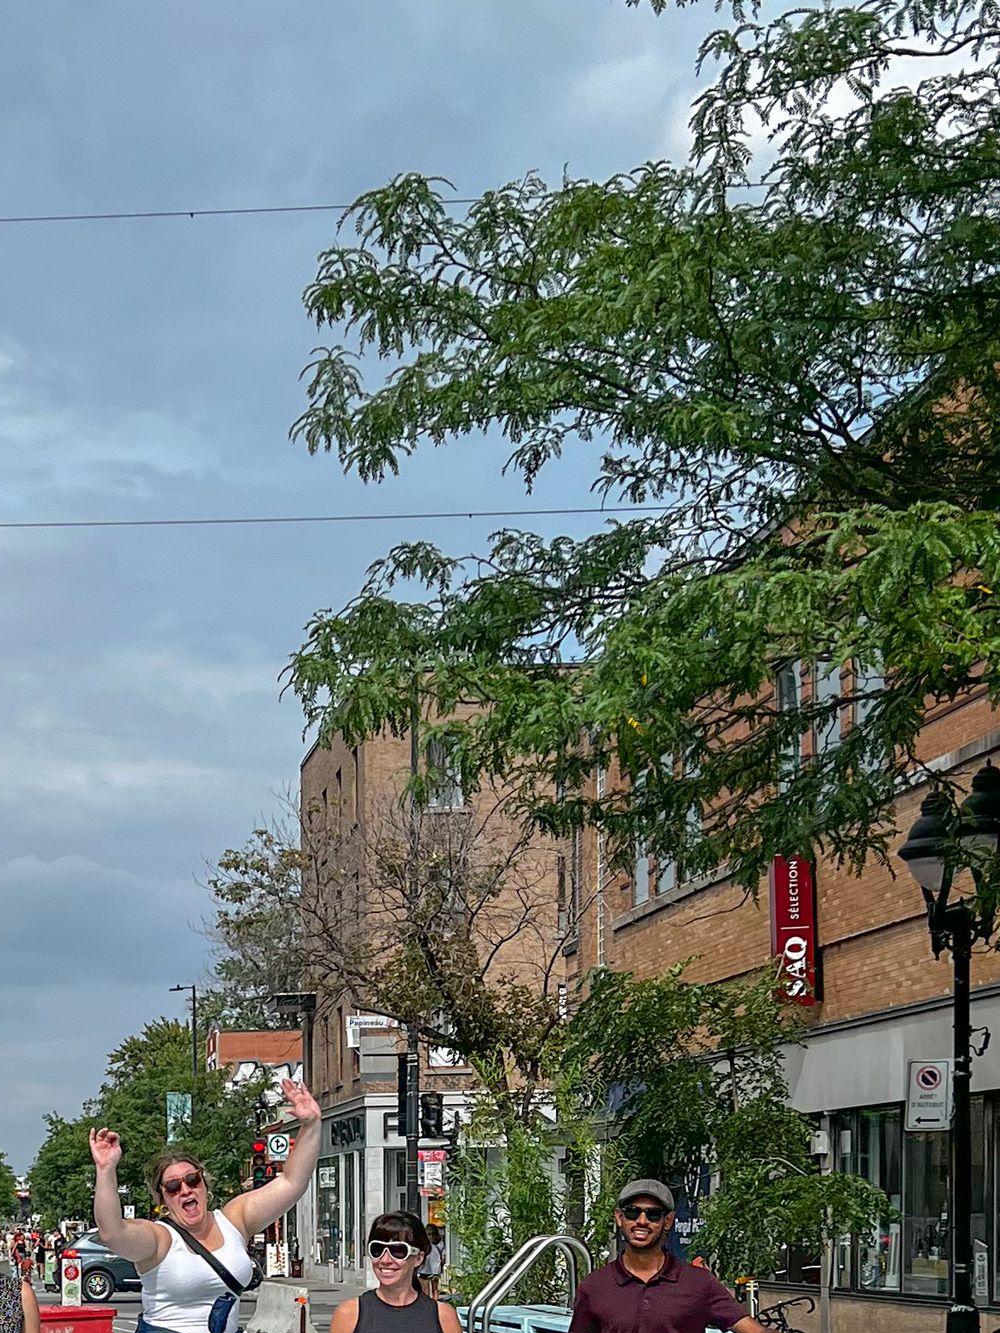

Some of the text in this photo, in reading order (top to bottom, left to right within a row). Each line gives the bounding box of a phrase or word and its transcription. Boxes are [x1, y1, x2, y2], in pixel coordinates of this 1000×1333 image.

[784, 860, 808, 997] SAQ SÉLECTION
[349, 1018, 385, 1027] Papineau
